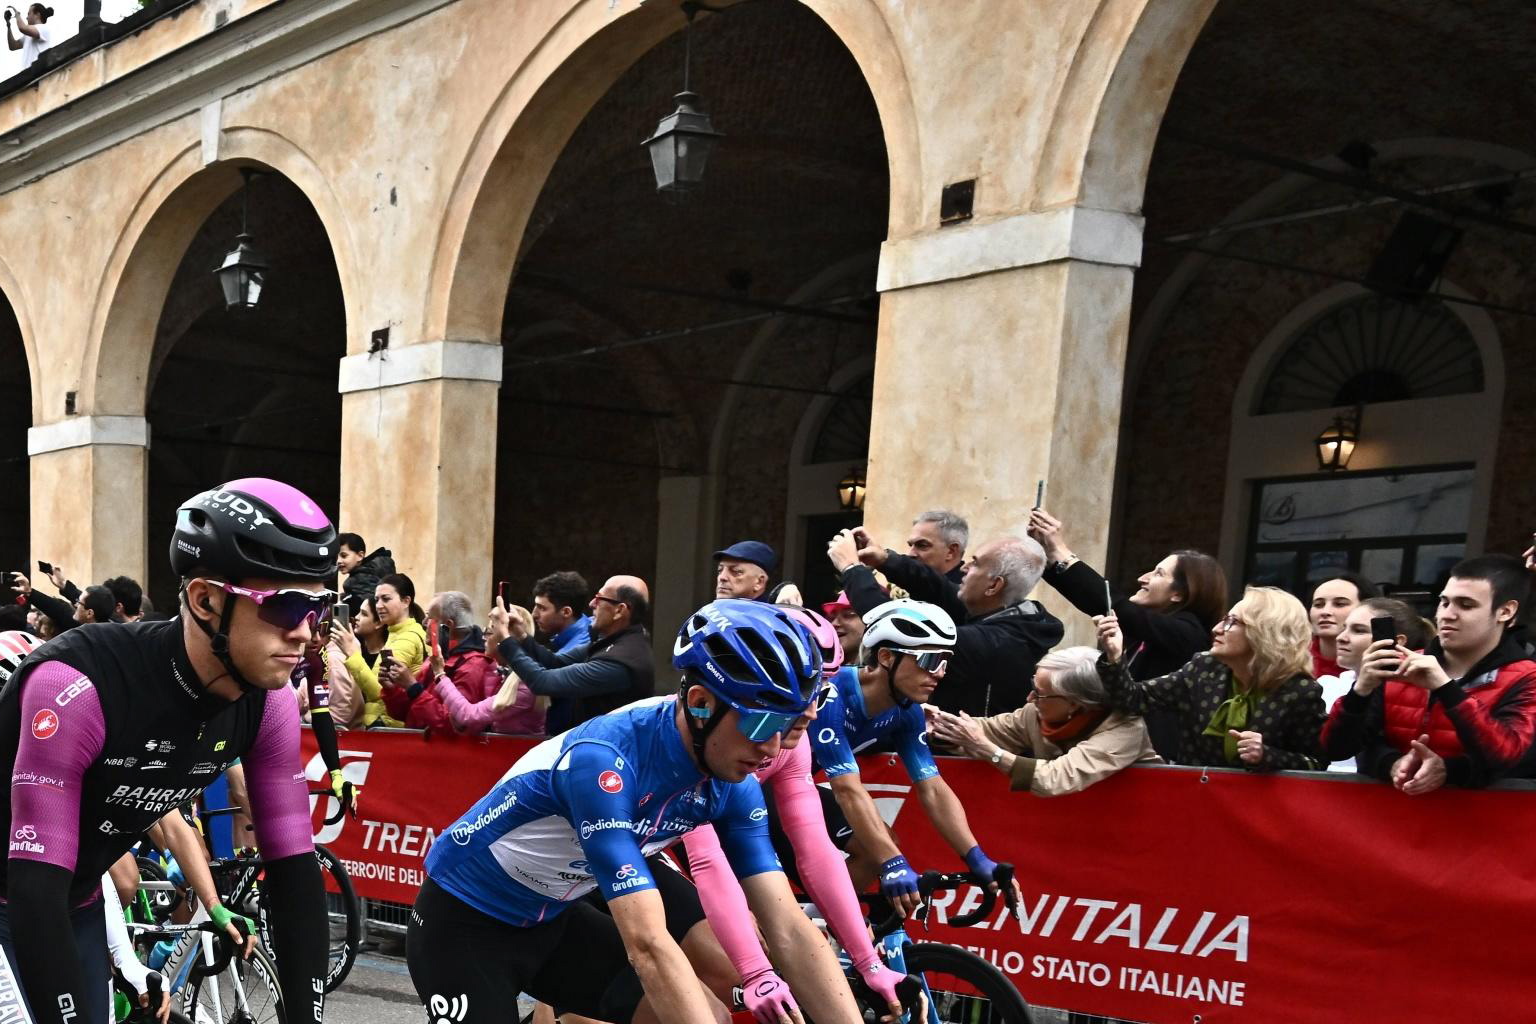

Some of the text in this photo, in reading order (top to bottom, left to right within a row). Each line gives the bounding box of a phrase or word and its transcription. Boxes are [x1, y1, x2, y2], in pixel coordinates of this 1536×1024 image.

[208, 490, 274, 526] UDY
[705, 661, 726, 684] KOMETA
[910, 885, 1251, 963] RENITALIA
[1031, 953, 1111, 988] STATO
[1118, 965, 1246, 1007] ITALIANE
